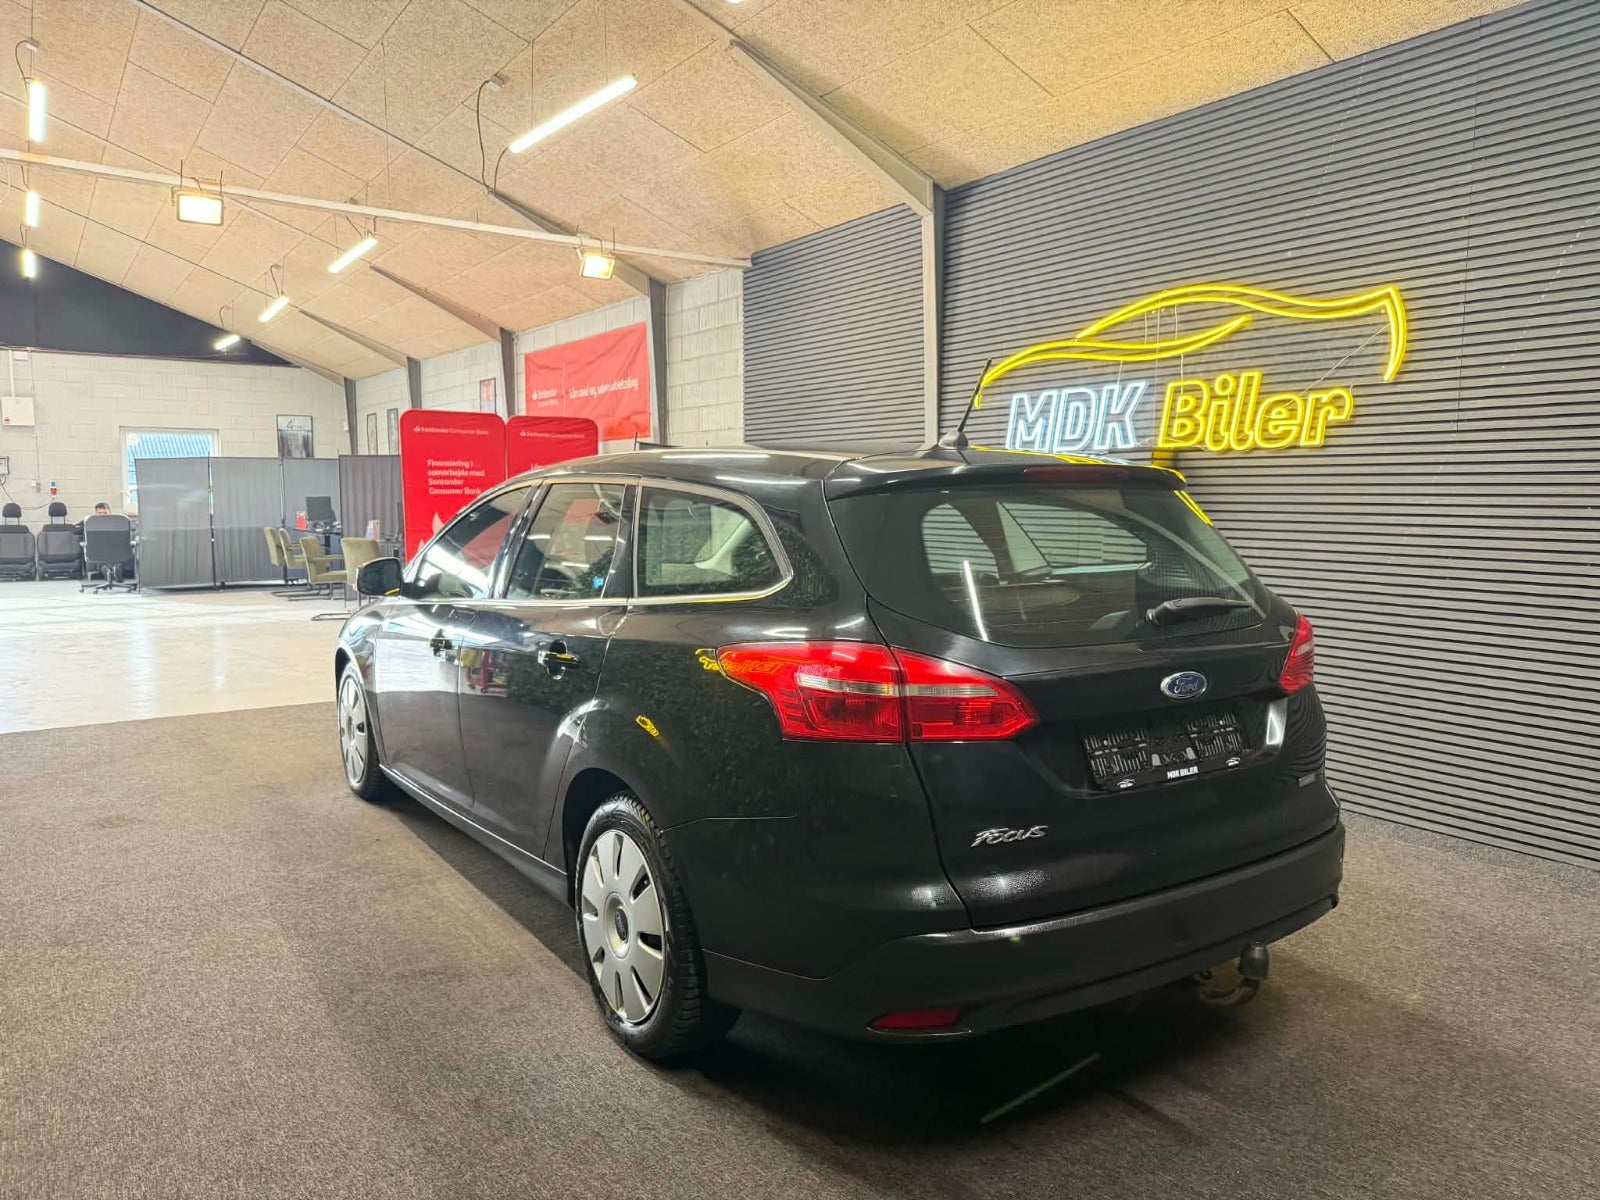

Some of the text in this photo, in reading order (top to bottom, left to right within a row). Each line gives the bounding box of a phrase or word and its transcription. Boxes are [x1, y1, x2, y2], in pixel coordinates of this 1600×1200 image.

[1005, 369, 1354, 452] MDK Biler
[427, 459, 470, 468] Finansiering
[427, 469, 469, 478] samarbejde
[428, 478, 464, 486] Santander
[428, 487, 463, 495] Consumer
